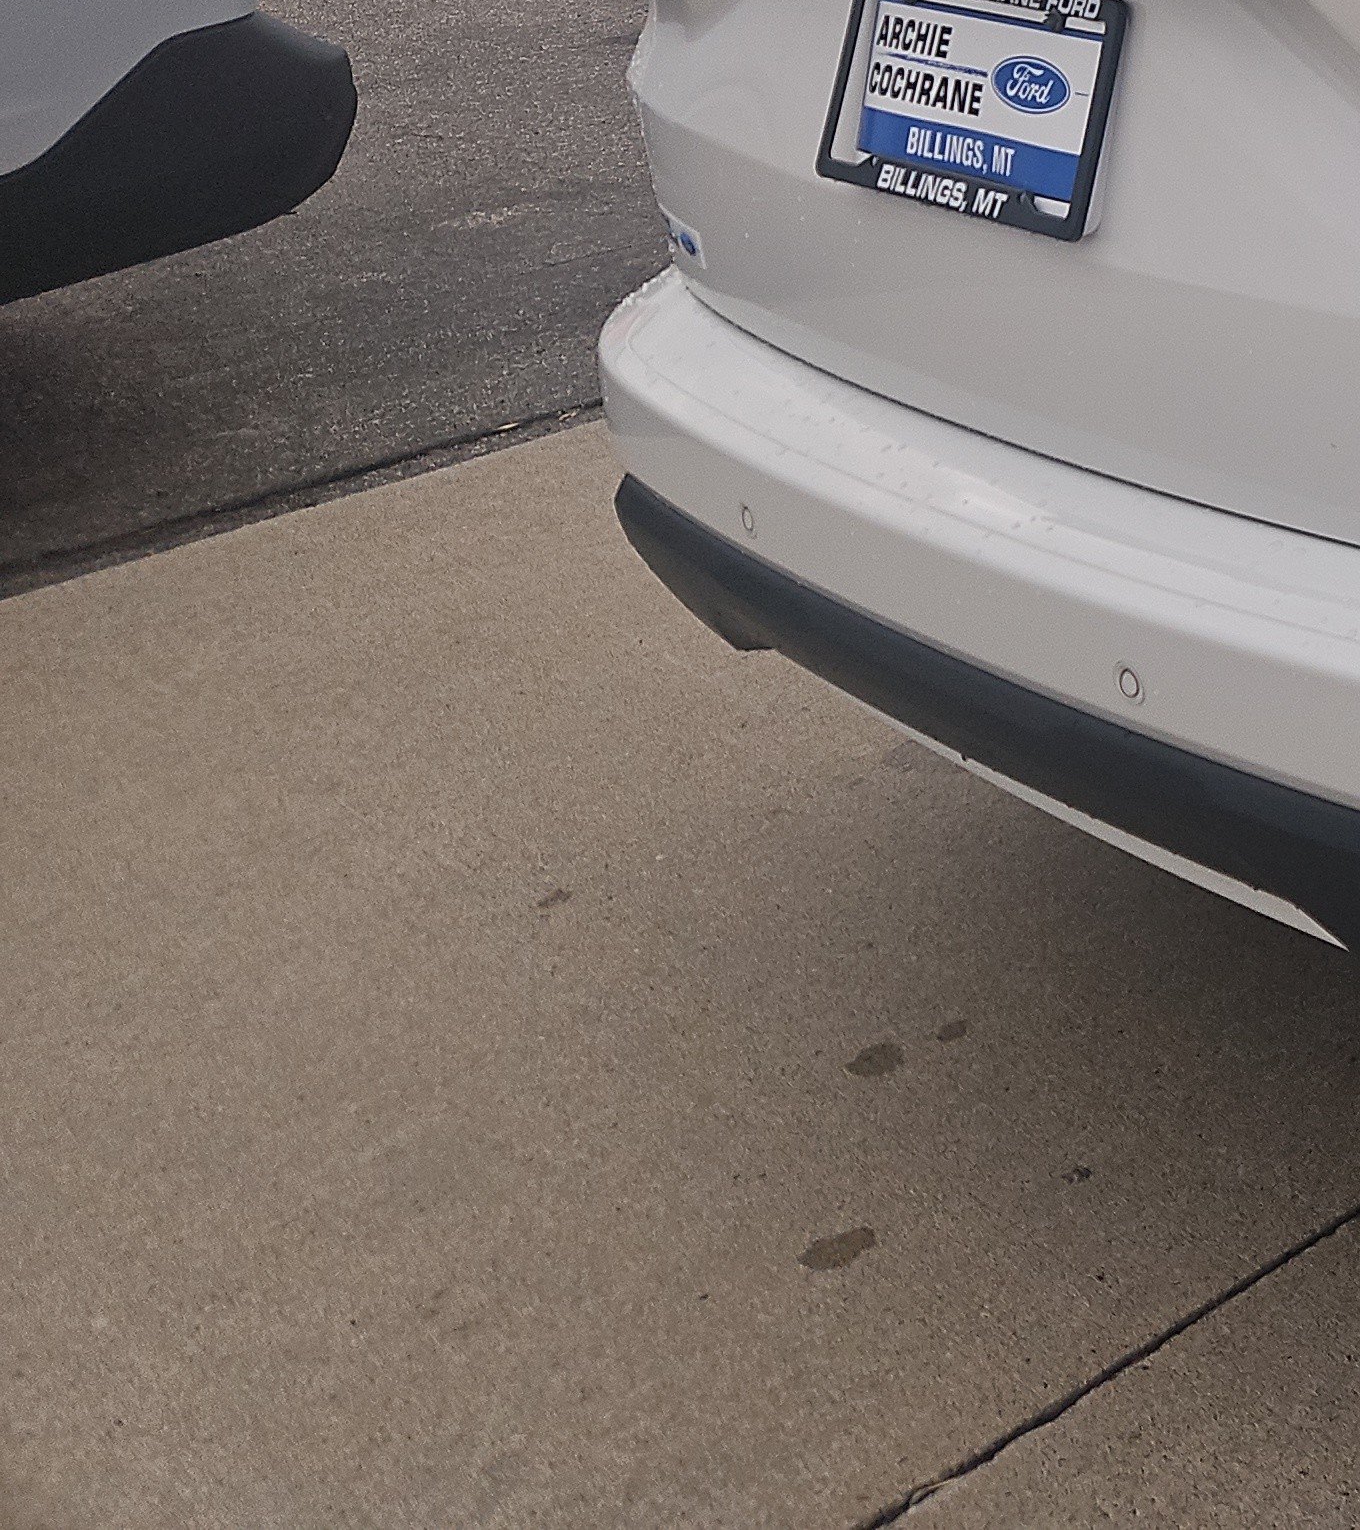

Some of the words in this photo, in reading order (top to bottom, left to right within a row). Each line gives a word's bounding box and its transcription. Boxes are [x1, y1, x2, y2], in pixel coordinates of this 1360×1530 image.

[876, 15, 953, 59] ARCHIE
[868, 62, 984, 116] COCHRANE
[1006, 63, 1054, 105] Ford
[906, 127, 988, 174] BILLINGS,
[992, 147, 1015, 177] MT
[877, 164, 967, 212] BILLINGS,
[972, 188, 1008, 218] MT
